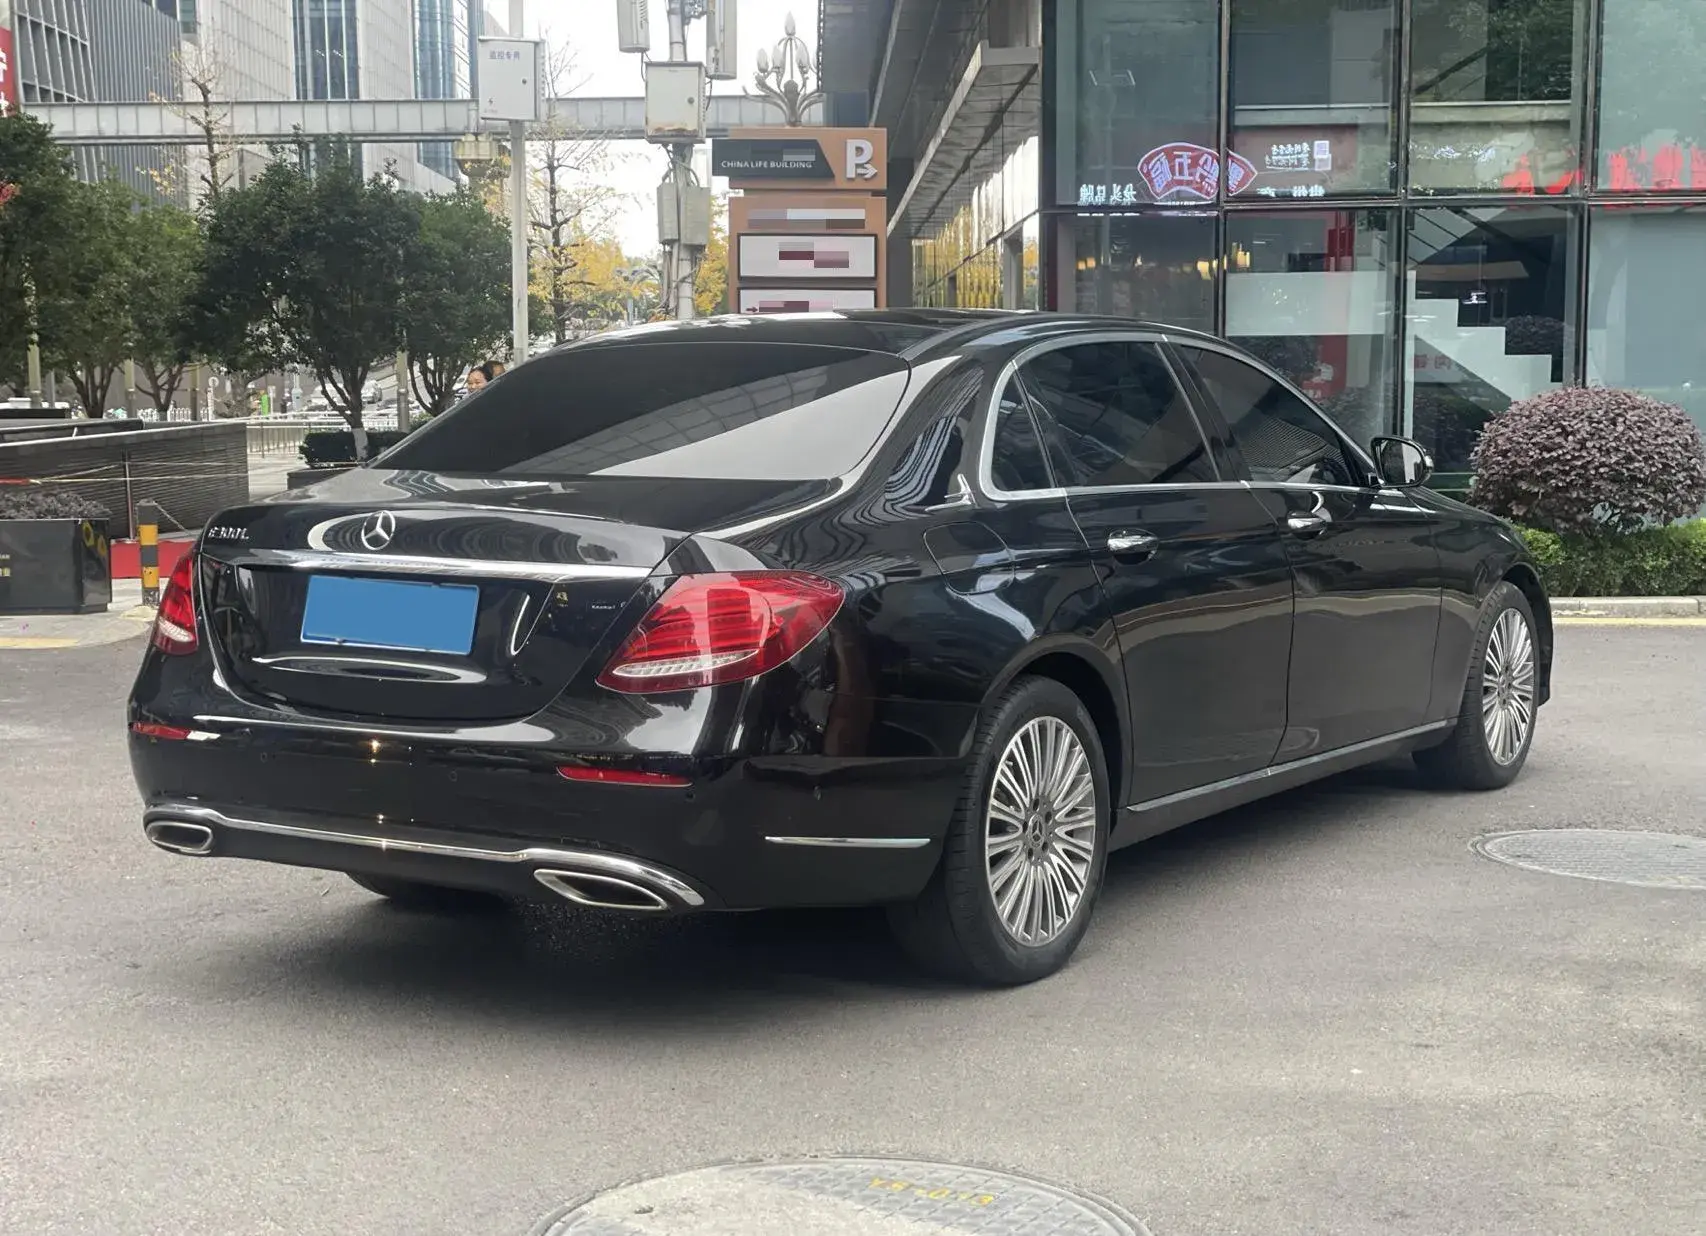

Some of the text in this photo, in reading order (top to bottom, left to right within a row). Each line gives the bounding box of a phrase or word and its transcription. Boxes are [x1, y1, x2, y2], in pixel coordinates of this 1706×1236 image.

[721, 160, 812, 168] CHINA LIFE BUILDING
[846, 139, 874, 178] P
